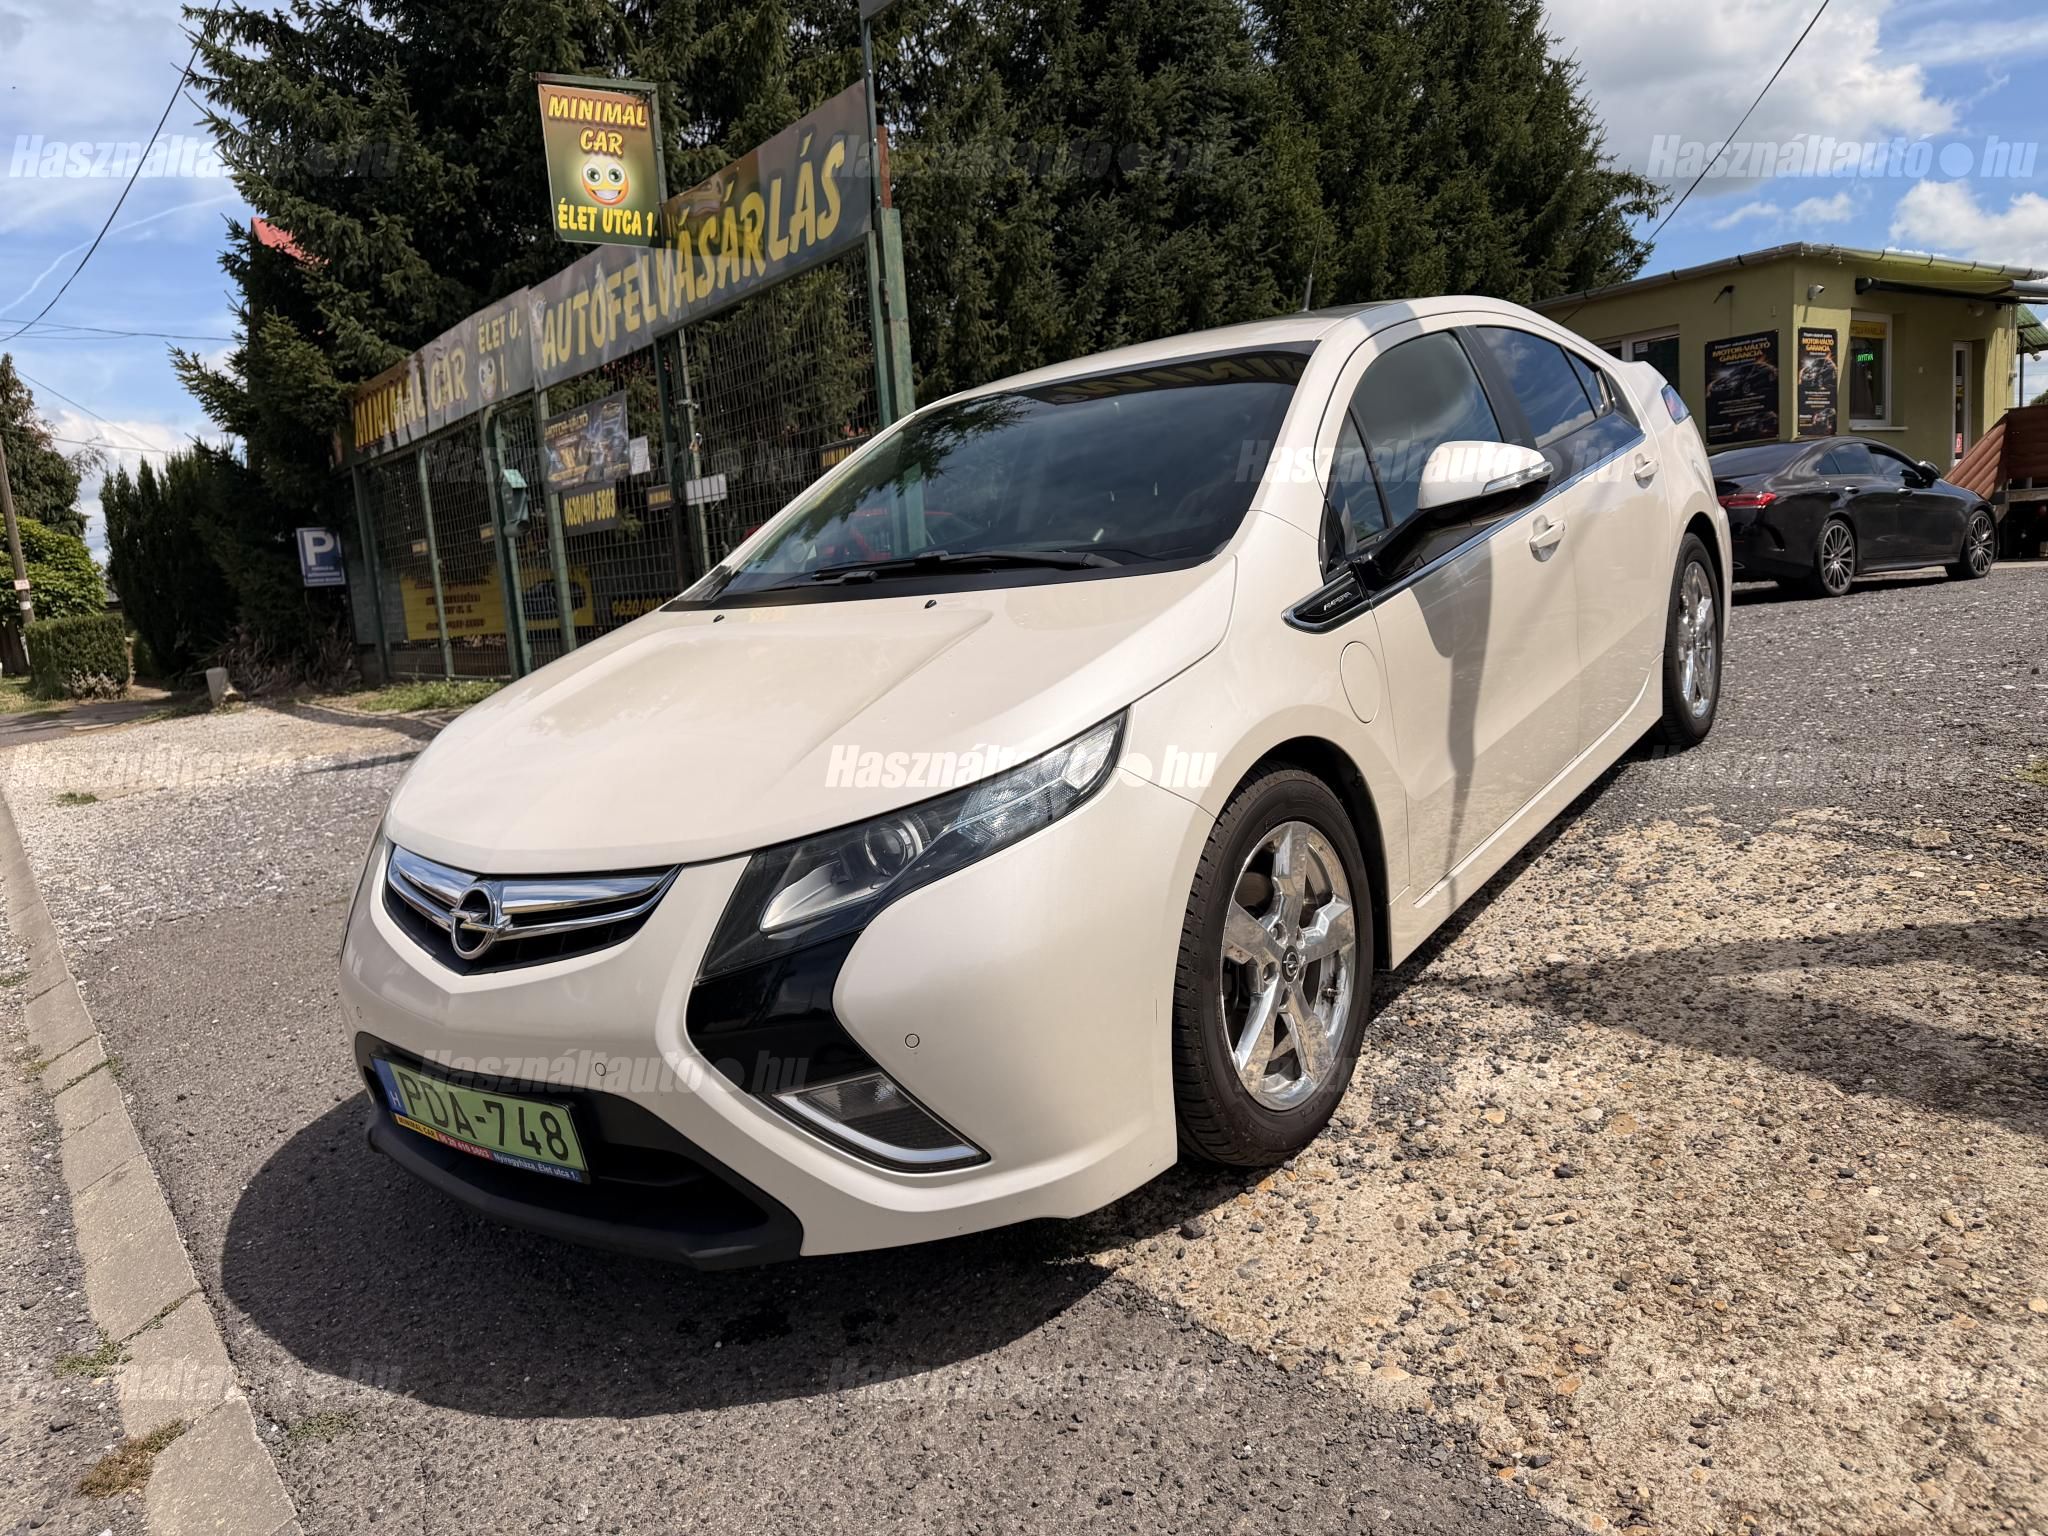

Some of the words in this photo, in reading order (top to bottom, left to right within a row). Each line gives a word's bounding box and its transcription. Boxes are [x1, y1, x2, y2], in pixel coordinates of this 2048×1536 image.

[548, 95, 647, 126] MINIMAL
[580, 130, 623, 155] CAR
[558, 198, 597, 232] ÉLET
[602, 207, 642, 236] UTCA
[541, 133, 845, 371] AUTÓFELVÁSÁRLÁS
[478, 318, 506, 354] ÉLET
[509, 308, 522, 339] U.
[354, 370, 426, 449] MINIMAL
[430, 347, 468, 410] CAR
[303, 531, 334, 565] P
[397, 1071, 569, 1161] PDA-748
